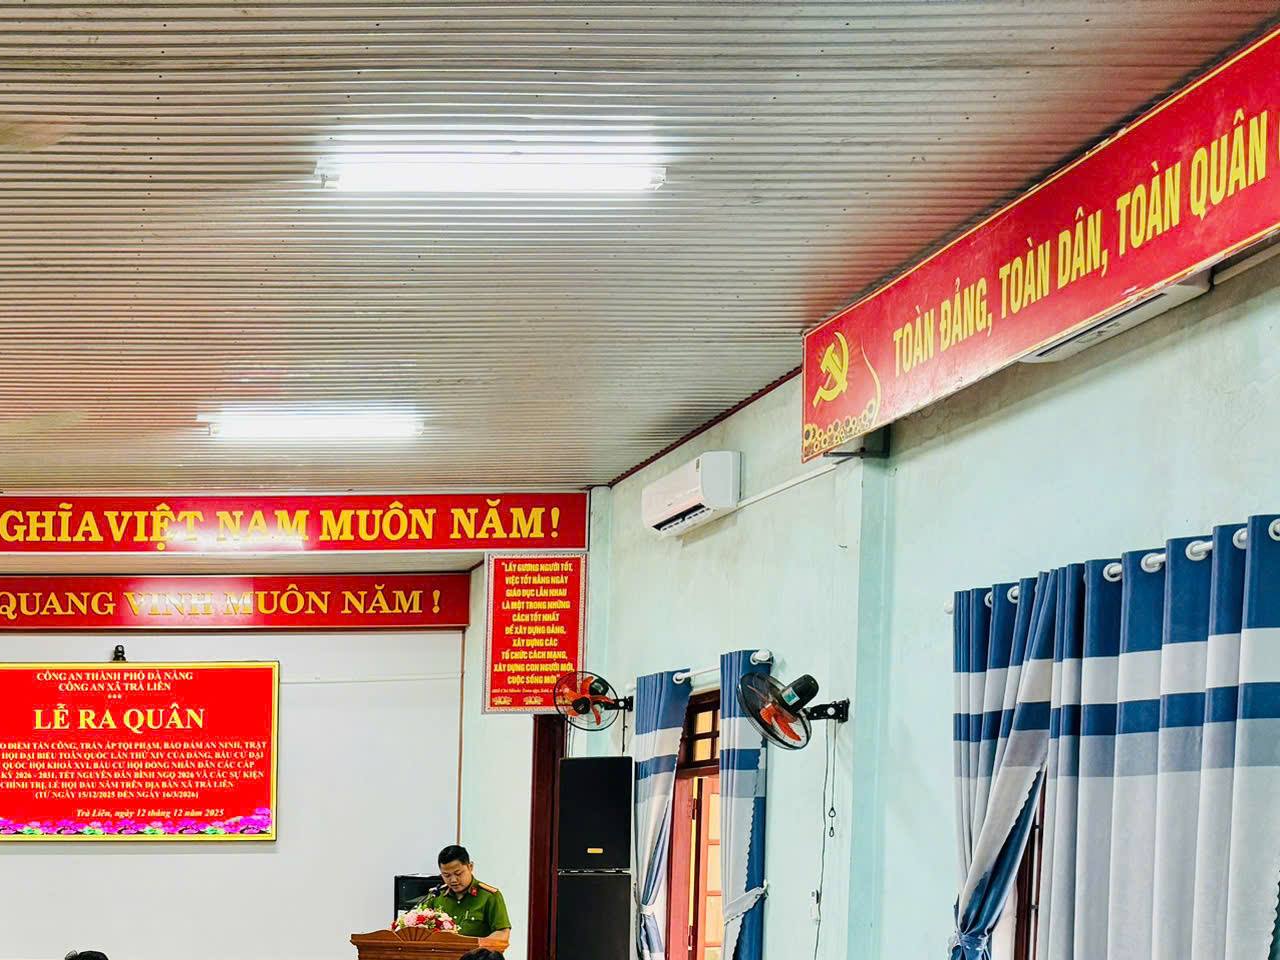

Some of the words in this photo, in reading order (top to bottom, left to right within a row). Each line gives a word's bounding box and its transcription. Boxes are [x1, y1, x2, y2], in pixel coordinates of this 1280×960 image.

[893, 305, 937, 377] TOÀN
[939, 277, 993, 353] ĐẢNG,
[999, 237, 1051, 320] TOÀN
[1057, 207, 1109, 290] DÂN,
[1116, 160, 1182, 256] TOÀN
[1190, 109, 1269, 221] QUÂN
[216, 510, 310, 541] NAM
[320, 501, 437, 541] MUÔN
[450, 499, 560, 539] NĂM!
[124, 590, 213, 616] VINH
[224, 583, 332, 616] MUÔN
[341, 582, 423, 614] NĂM
[36, 670, 67, 681] CÔNG
[70, 672, 85, 681] AN
[59, 681, 89, 691] CÔNG
[91, 683, 105, 691] AN
[34, 703, 70, 730] LỄ
[78, 709, 117, 730] RA
[123, 702, 205, 734] QUÂN
[136, 808, 146, 817] 12
